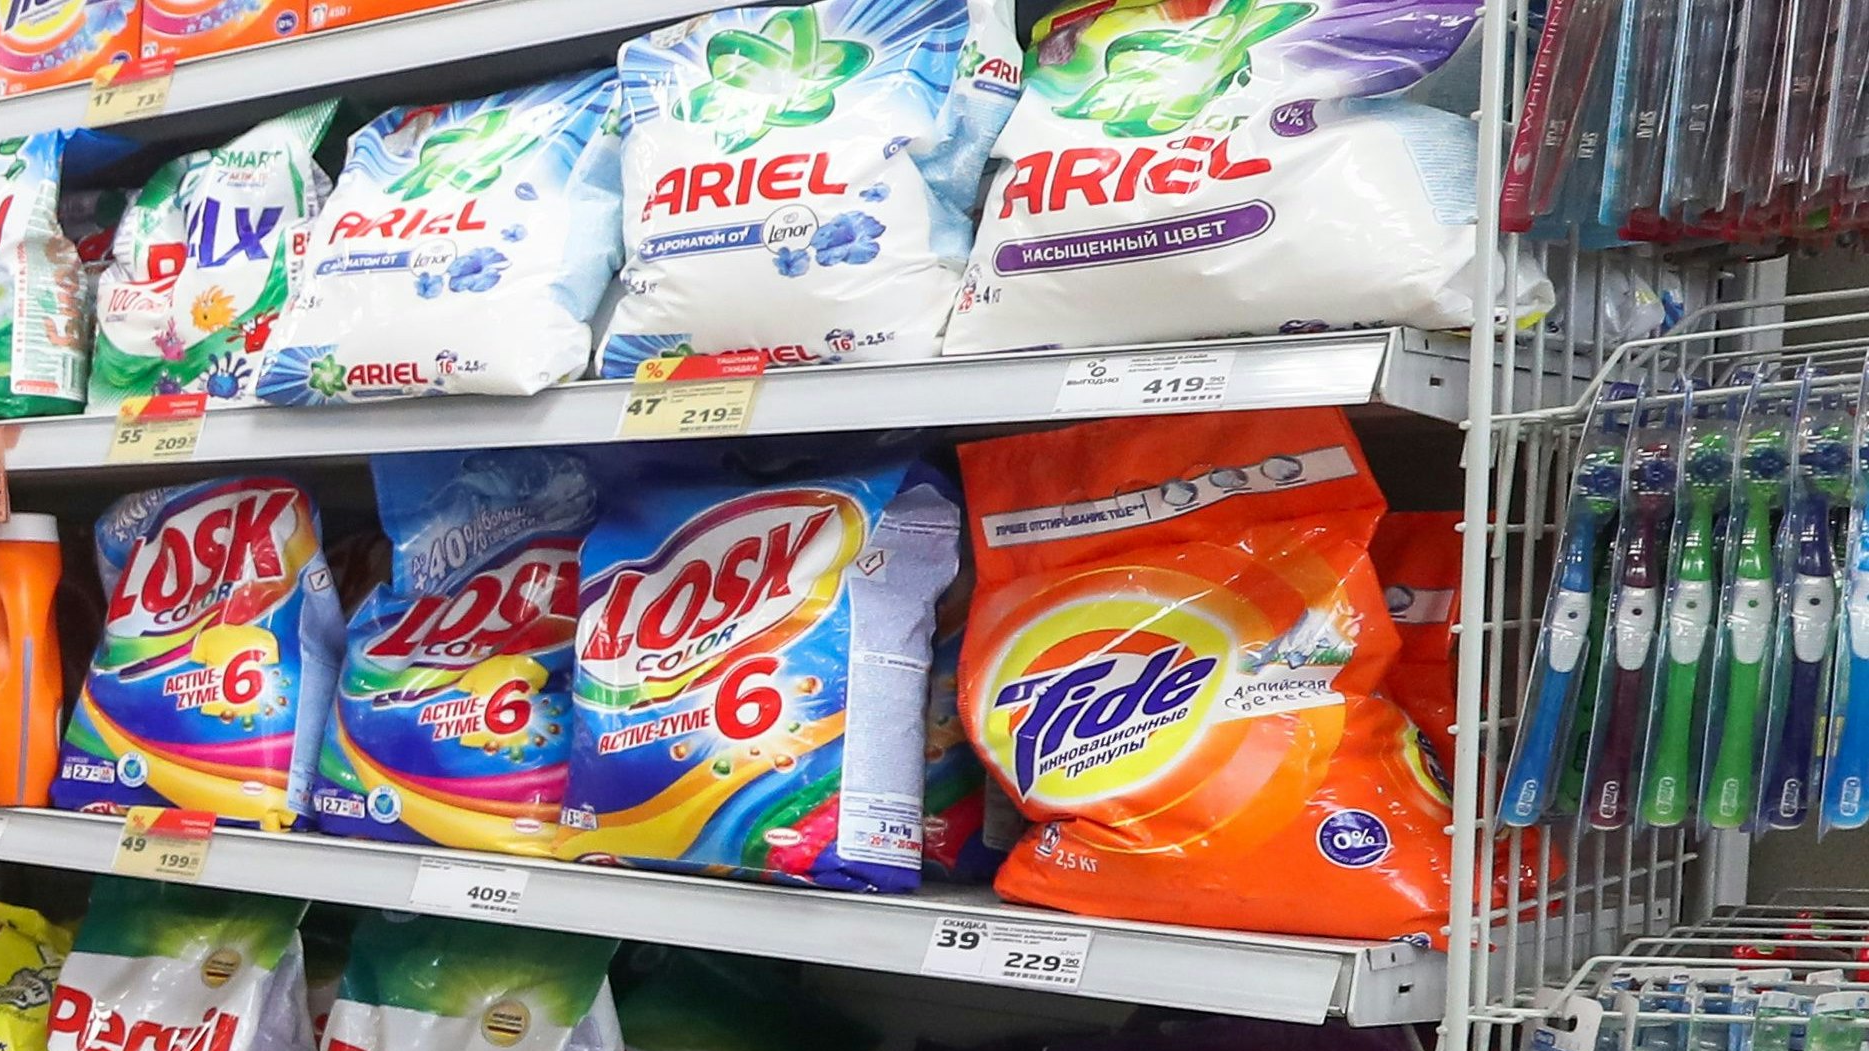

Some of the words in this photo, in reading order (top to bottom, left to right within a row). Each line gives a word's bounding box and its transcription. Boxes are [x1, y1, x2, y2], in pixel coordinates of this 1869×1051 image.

[641, 152, 848, 224] ARIEL
[999, 135, 1272, 220] ARIEL
[328, 198, 486, 246] ARIEL
[656, 231, 726, 254] АРОМАТОМ
[768, 221, 812, 246] Lenor
[1022, 229, 1159, 263] НАСЫЩЕННЫЙ
[1164, 219, 1227, 244] ЦВЕТ
[832, 338, 851, 352] 16
[347, 362, 428, 385] ARIEL
[1143, 377, 1205, 394] 419
[627, 398, 663, 415] 47
[680, 408, 727, 424] 219
[117, 429, 143, 445] 55
[154, 438, 188, 452] 209
[108, 488, 298, 624] LOSK
[582, 504, 837, 663] LOSK
[636, 623, 737, 672] COLOR
[163, 670, 223, 696] ACTIVE-
[222, 649, 267, 705] 6
[176, 685, 221, 710] ZYME
[483, 679, 533, 734] 6
[714, 656, 783, 741] 6
[418, 698, 485, 726] ACTIVE-
[993, 643, 1218, 802] Tide
[433, 716, 481, 743] ZYME
[598, 711, 711, 755] ACTIVE-ZYME
[1038, 706, 1188, 775] инновационные
[1065, 736, 1146, 780] гранулы
[122, 837, 146, 852] 49
[1333, 829, 1375, 848] 0%
[159, 854, 190, 869] 199
[1054, 847, 1077, 869] 2,5
[467, 884, 507, 904] 409
[943, 919, 988, 930] СКИДКА
[1004, 952, 1061, 972] 229
